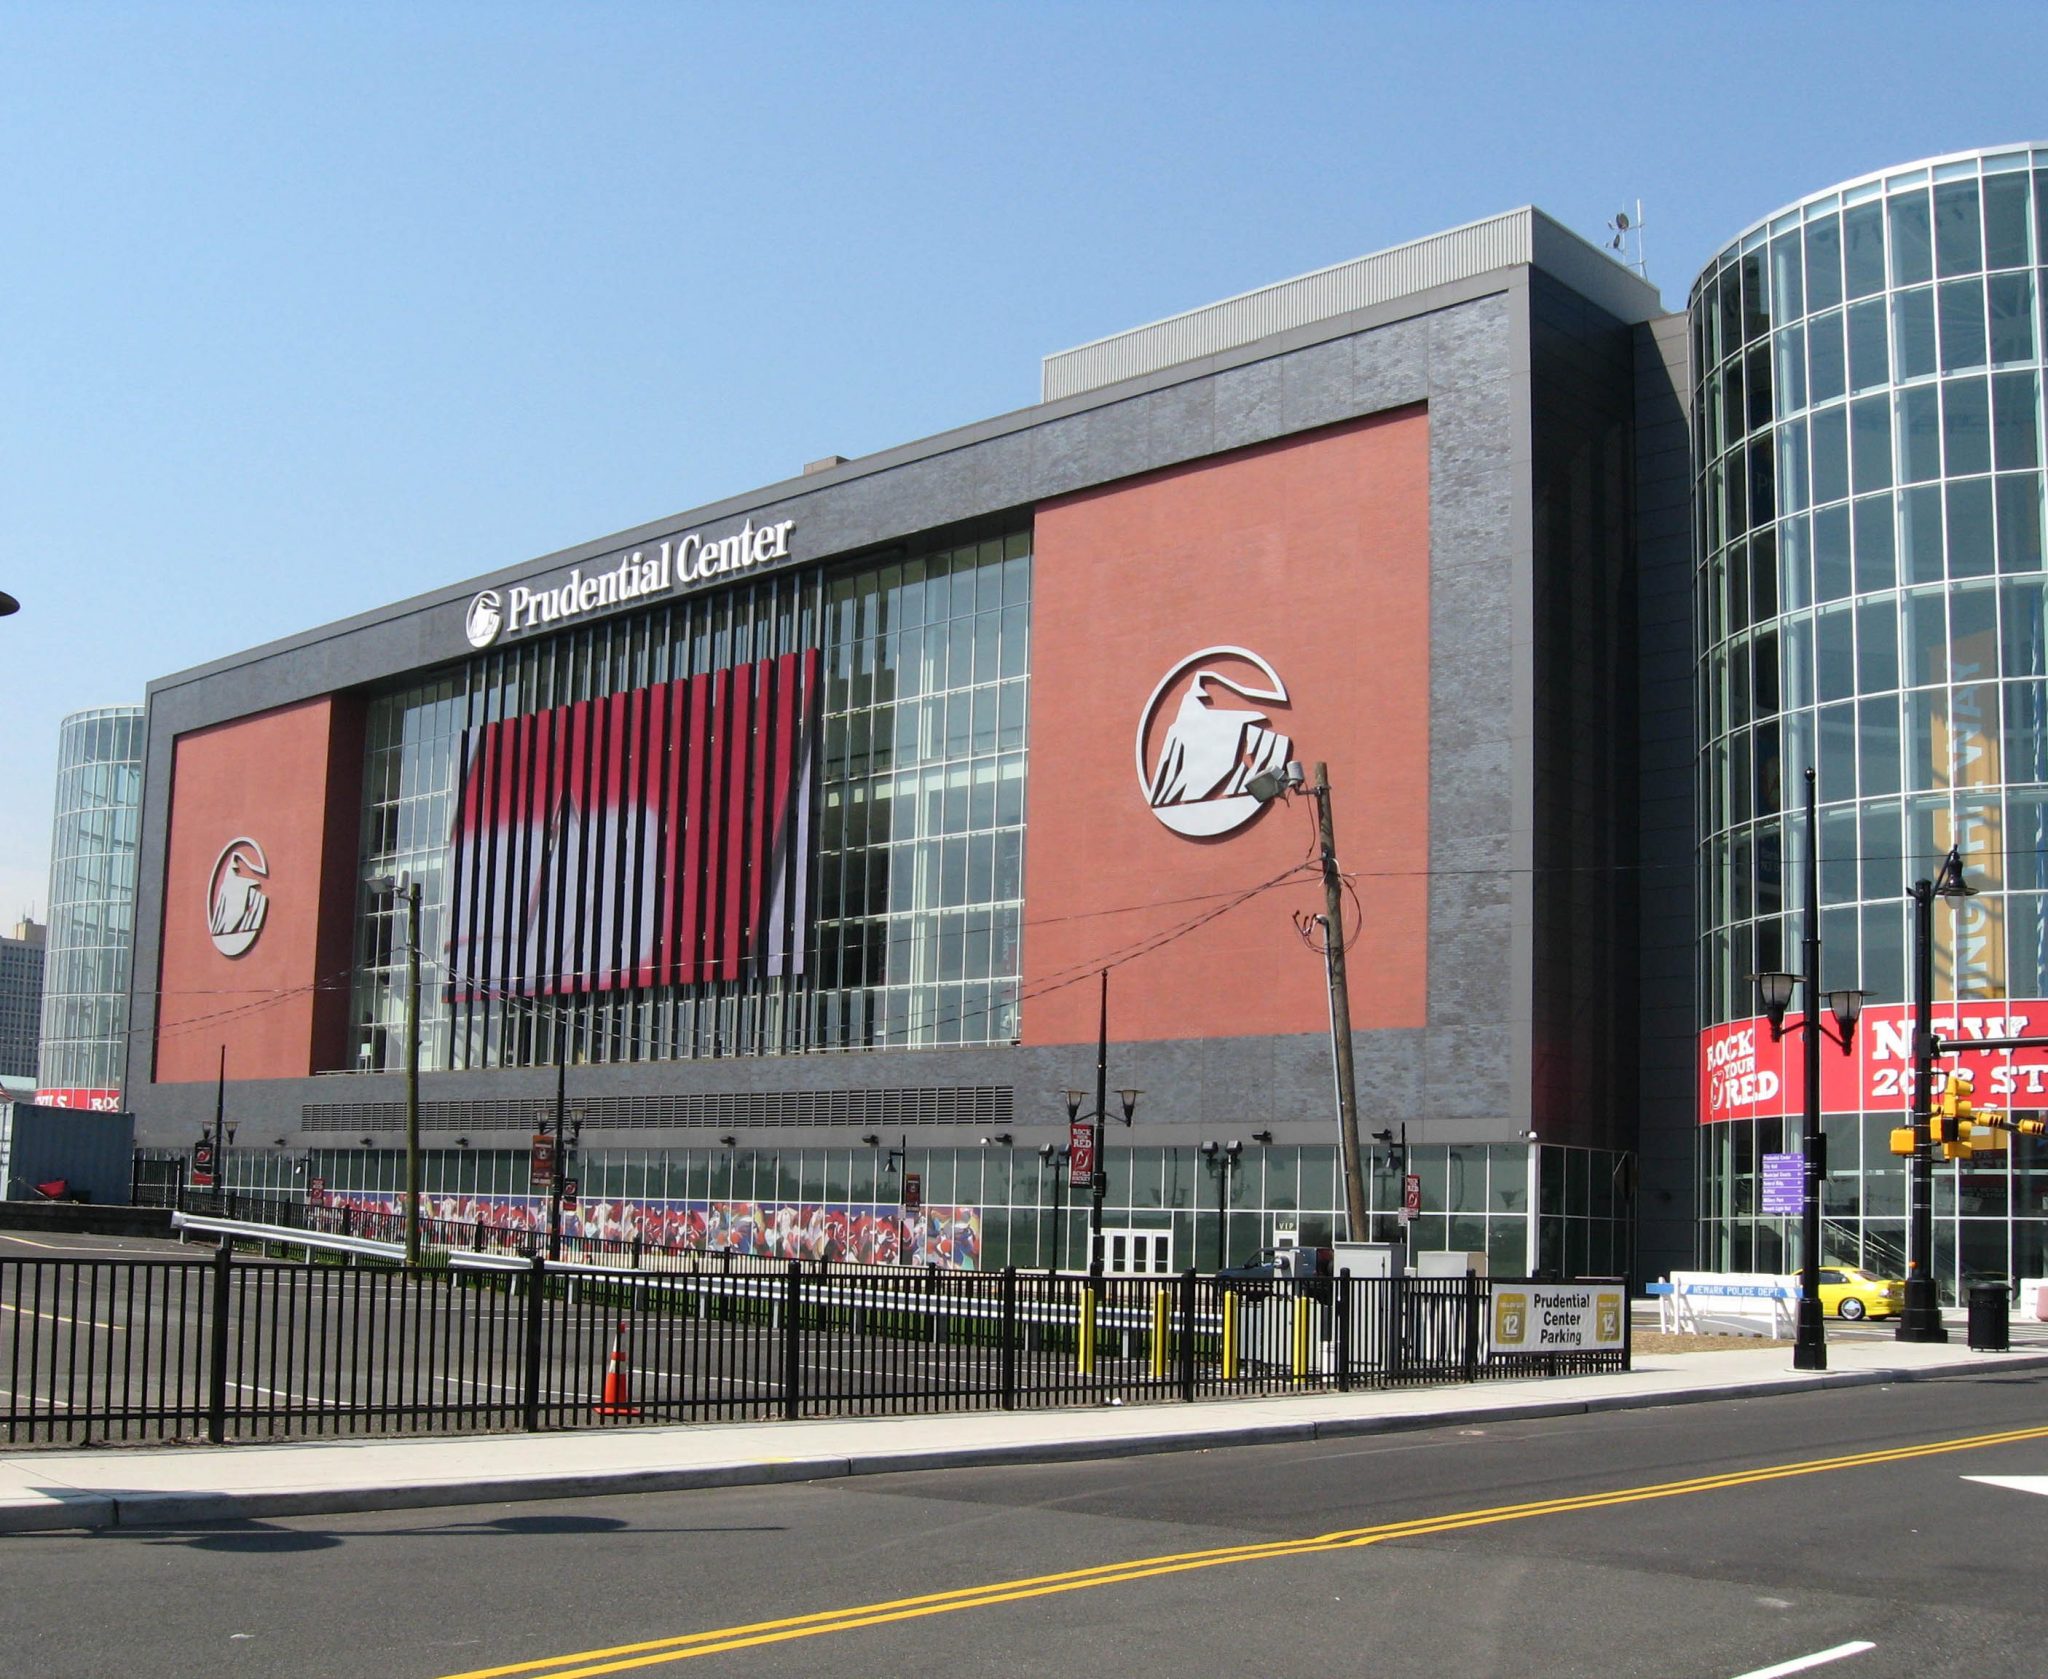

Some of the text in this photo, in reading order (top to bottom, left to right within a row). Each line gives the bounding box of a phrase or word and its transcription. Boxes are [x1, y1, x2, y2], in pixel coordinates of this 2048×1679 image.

[507, 518, 797, 633] Prudential Center
[1946, 661, 1983, 773] WAY
[1948, 899, 1988, 1000] ING
[1706, 1028, 1755, 1072] ROCK
[1723, 1056, 1755, 1079] YOUR
[1725, 1070, 1779, 1109] RED
[1072, 1128, 1092, 1136] ROCK
[1073, 1139, 1092, 1148] RED
[1278, 1222, 1294, 1230] VIP
[1533, 1293, 1590, 1308] Prudential
[1693, 1285, 1781, 1297] NEWARK POLICE DEPT.
[1504, 1315, 1518, 1335] 12
[1543, 1311, 1581, 1326] Center
[1602, 1313, 1615, 1334] 12
[1540, 1329, 1582, 1346] Parking
